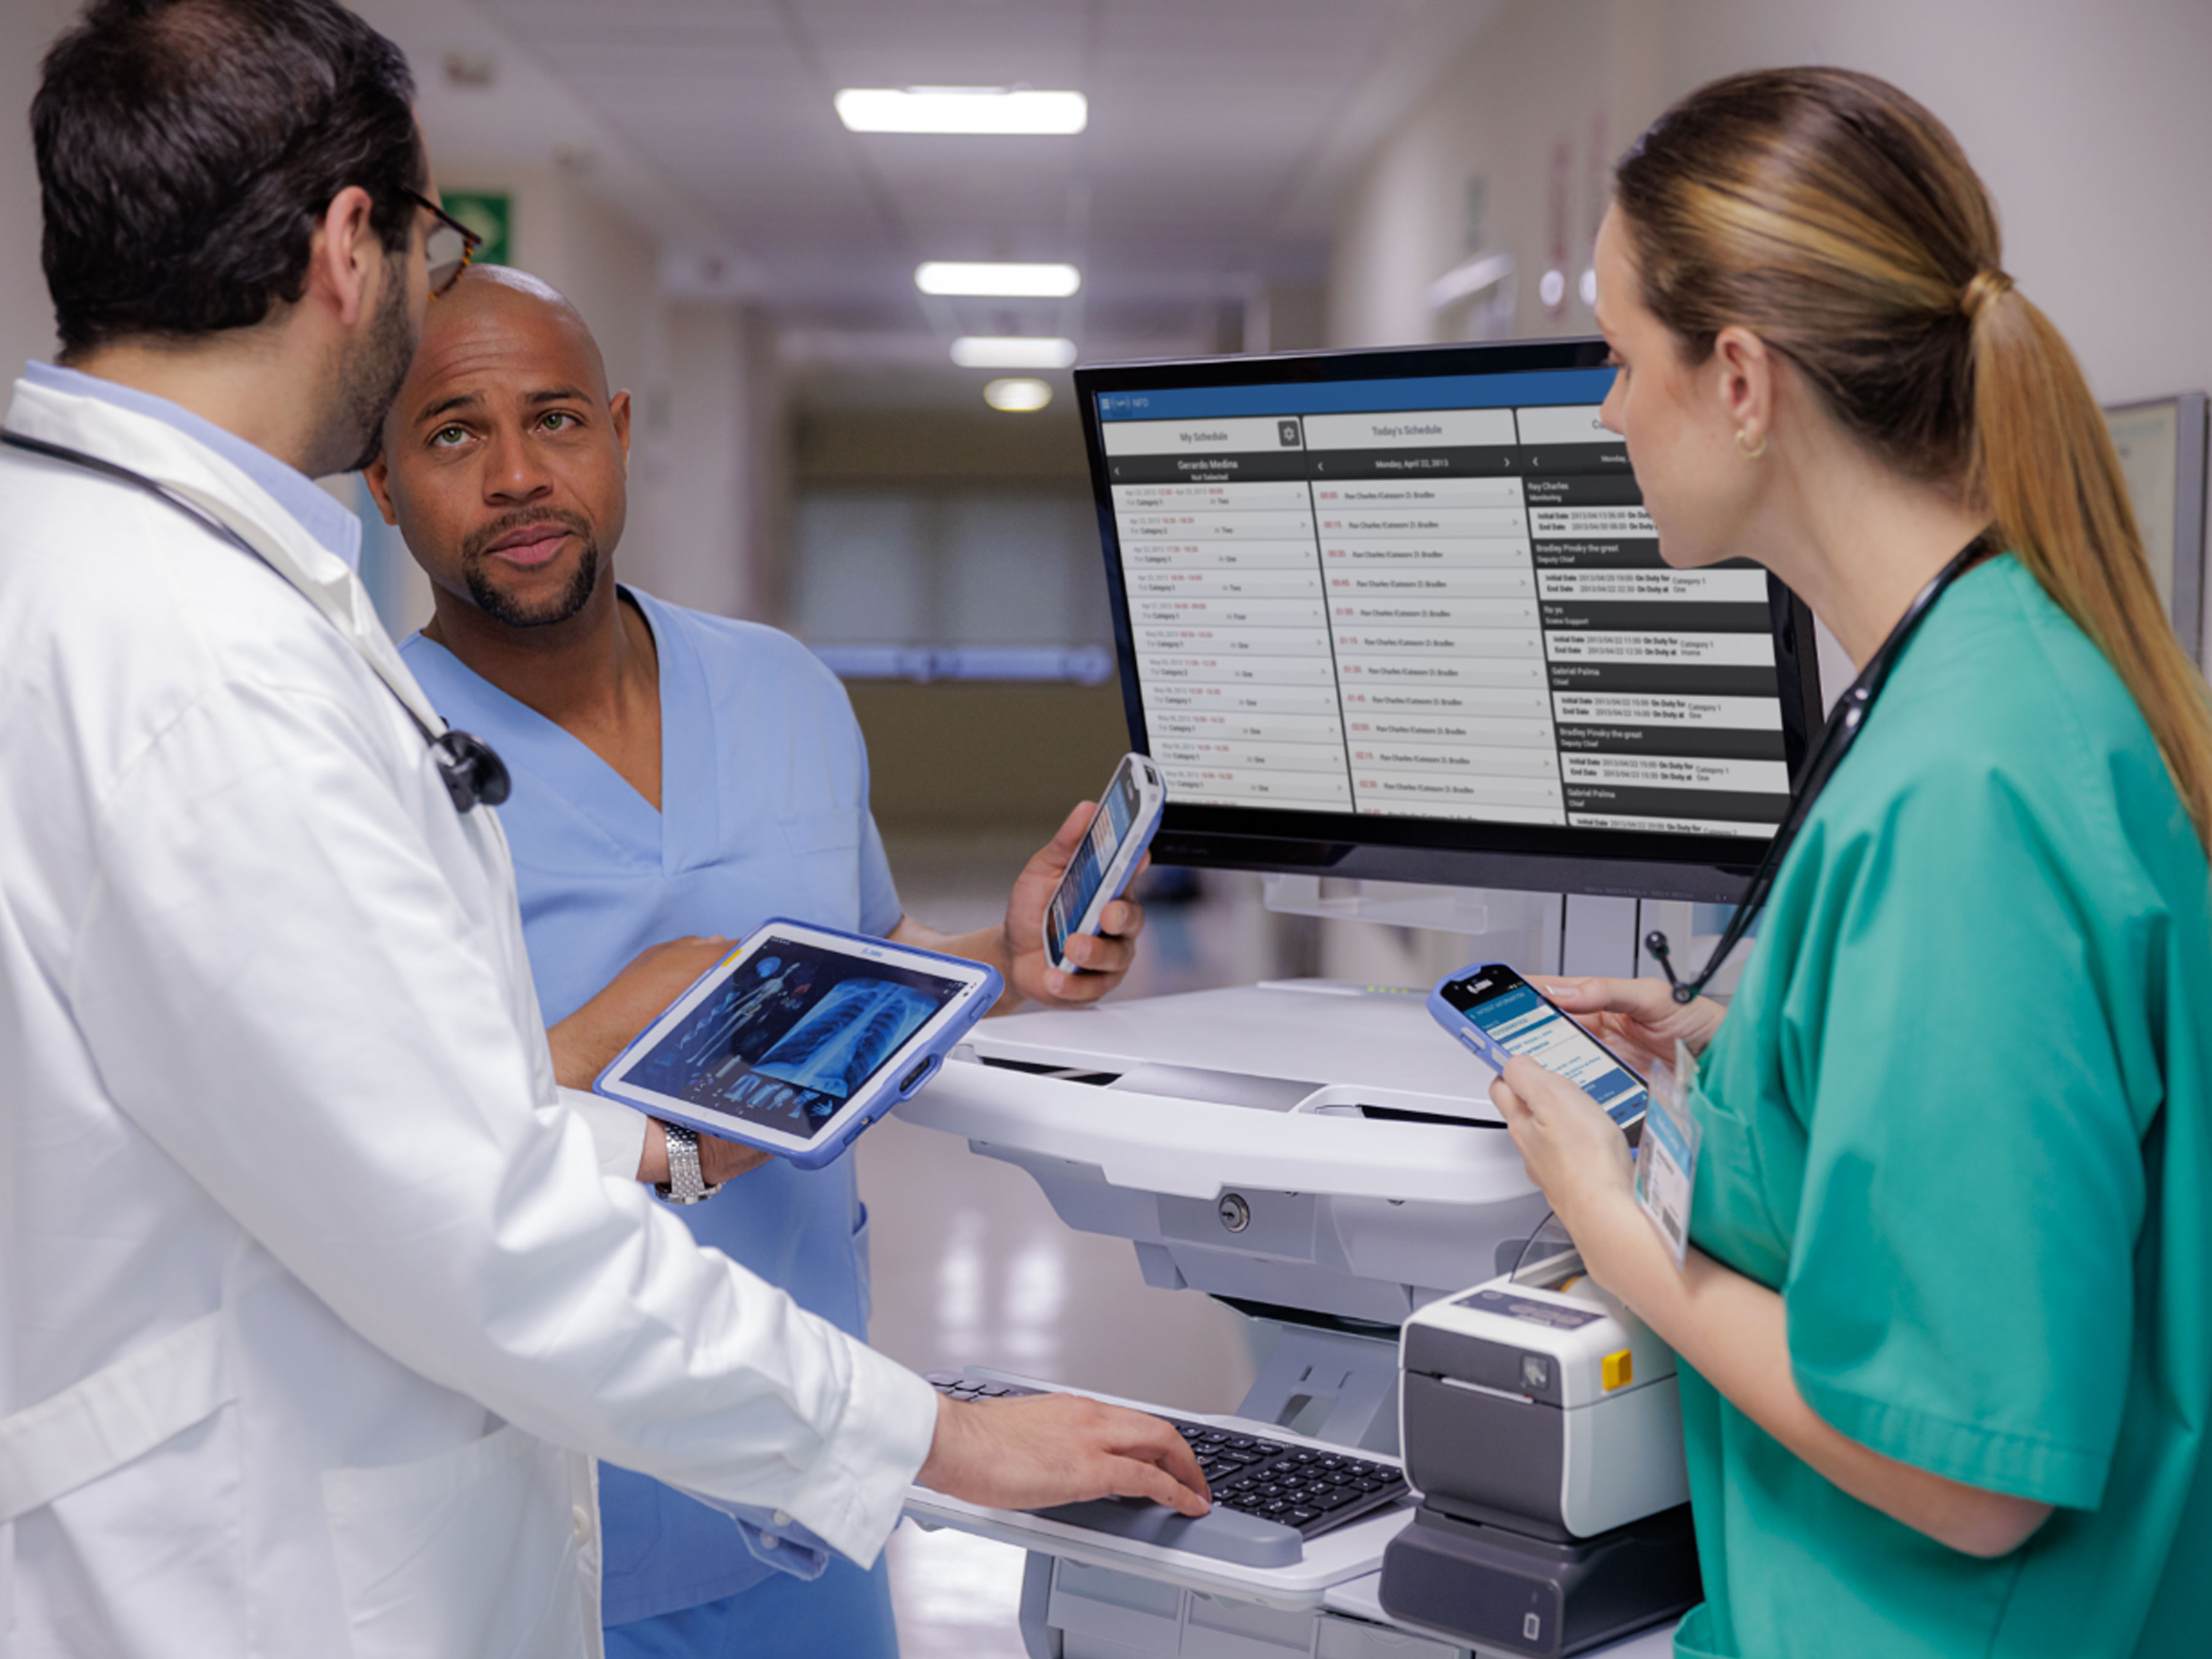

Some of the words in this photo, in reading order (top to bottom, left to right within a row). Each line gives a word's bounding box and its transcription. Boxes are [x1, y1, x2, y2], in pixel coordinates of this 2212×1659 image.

[1371, 425, 1403, 438] Today's
[1403, 423, 1443, 435] Schedule
[1180, 432, 1193, 443] My
[1193, 431, 1228, 441] Schedule
[1177, 459, 1209, 470] Gerardo
[1209, 458, 1238, 469] Medina
[1375, 460, 1403, 469] Monday,
[1403, 459, 1420, 469] April
[1528, 482, 1541, 492] Ray
[1542, 482, 1569, 490] Charles
[1529, 493, 1561, 503] Monitoring
[1639, 522, 1653, 531] Duty
[1535, 544, 1562, 553] Bradley
[1564, 618, 1589, 626] Support
[1559, 728, 1586, 737] Bradley
[1561, 739, 1582, 748] Deputy
[1669, 762, 1683, 771] Duty
[1695, 766, 1724, 774] Category
[1567, 788, 1591, 797] Gabriel
[1677, 824, 1691, 833] Duty
